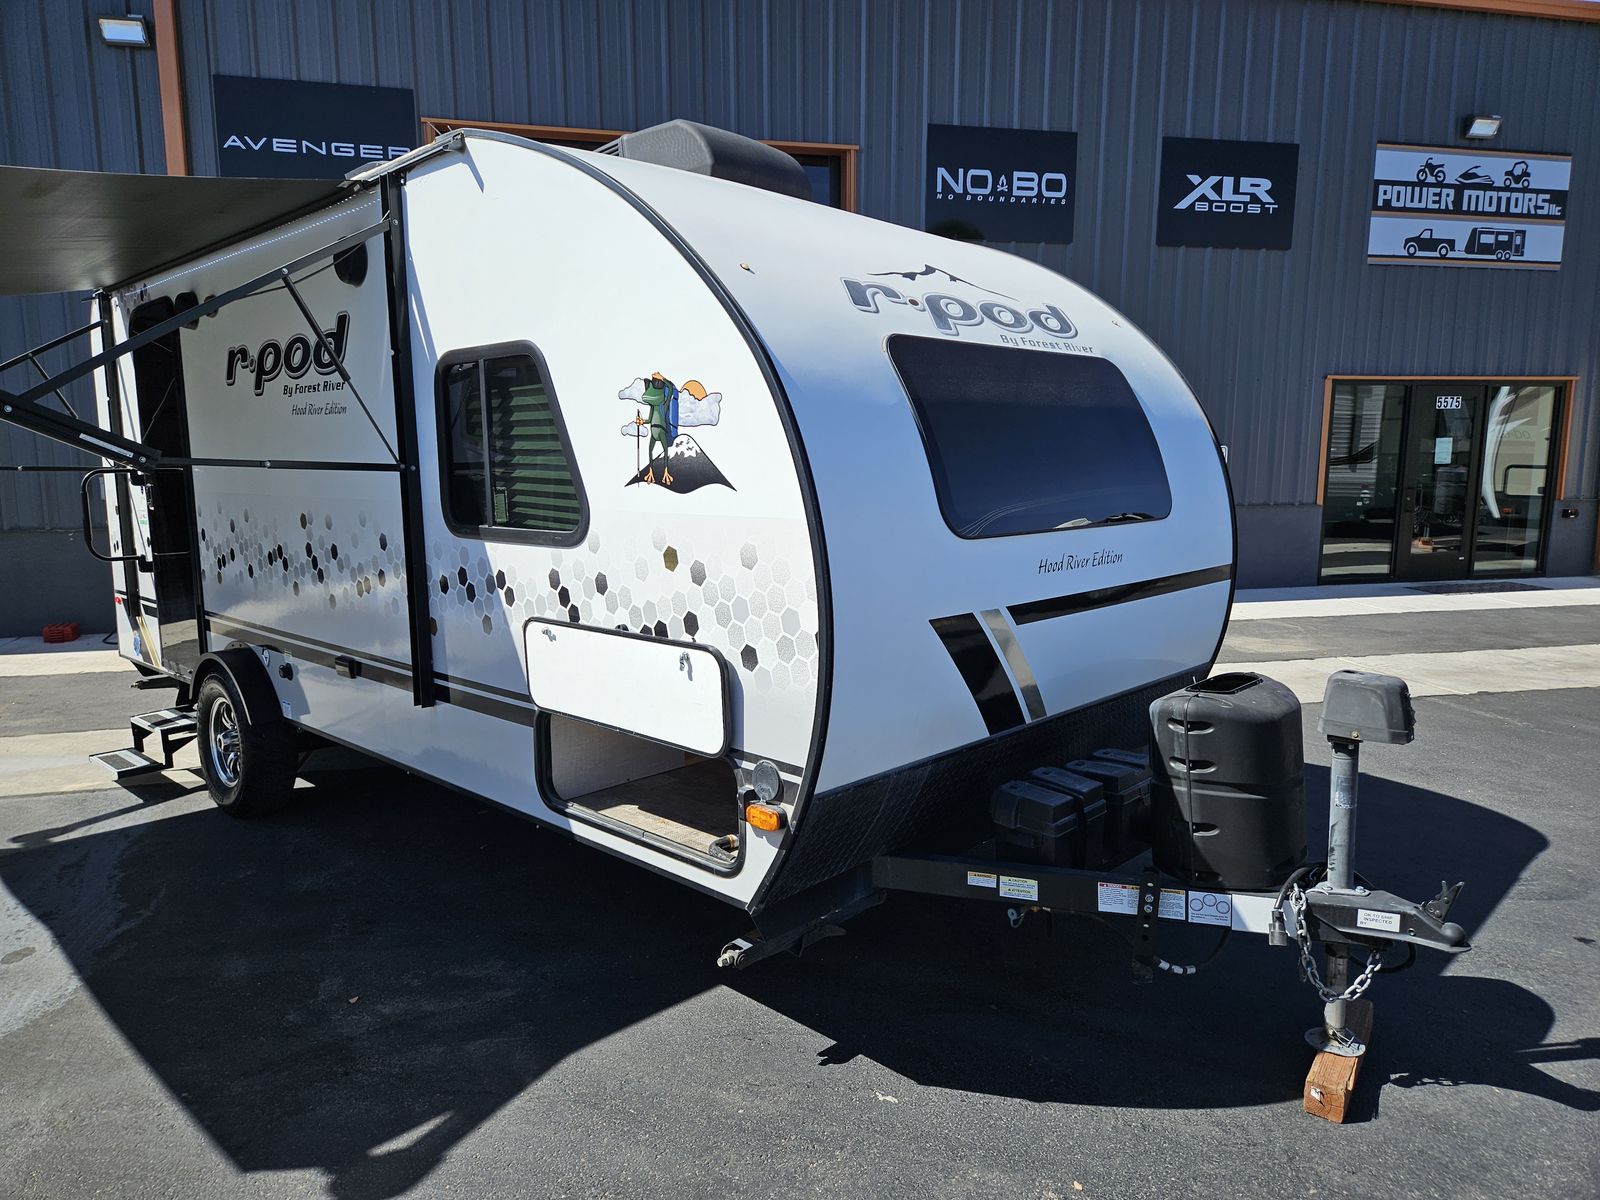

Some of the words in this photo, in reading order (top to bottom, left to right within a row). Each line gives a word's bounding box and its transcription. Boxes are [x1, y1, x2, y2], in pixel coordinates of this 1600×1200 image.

[936, 193, 955, 201] NO
[966, 194, 1067, 205] BOUNDARIES
[1173, 174, 1275, 209] XLR
[1377, 184, 1455, 211] POWER
[1194, 201, 1279, 214] BOOST
[1000, 334, 1019, 347] By
[1020, 337, 1063, 351] Forest
[1064, 342, 1094, 354] River
[283, 384, 293, 397] By
[294, 382, 321, 395] Forest
[322, 380, 346, 392] River
[291, 402, 308, 416] Hood
[308, 403, 323, 416] River
[324, 401, 348, 416] Edition
[1436, 396, 1461, 408] 5575
[1038, 553, 1066, 575] Hood
[1066, 554, 1090, 571] River
[1092, 548, 1123, 567] Edition
